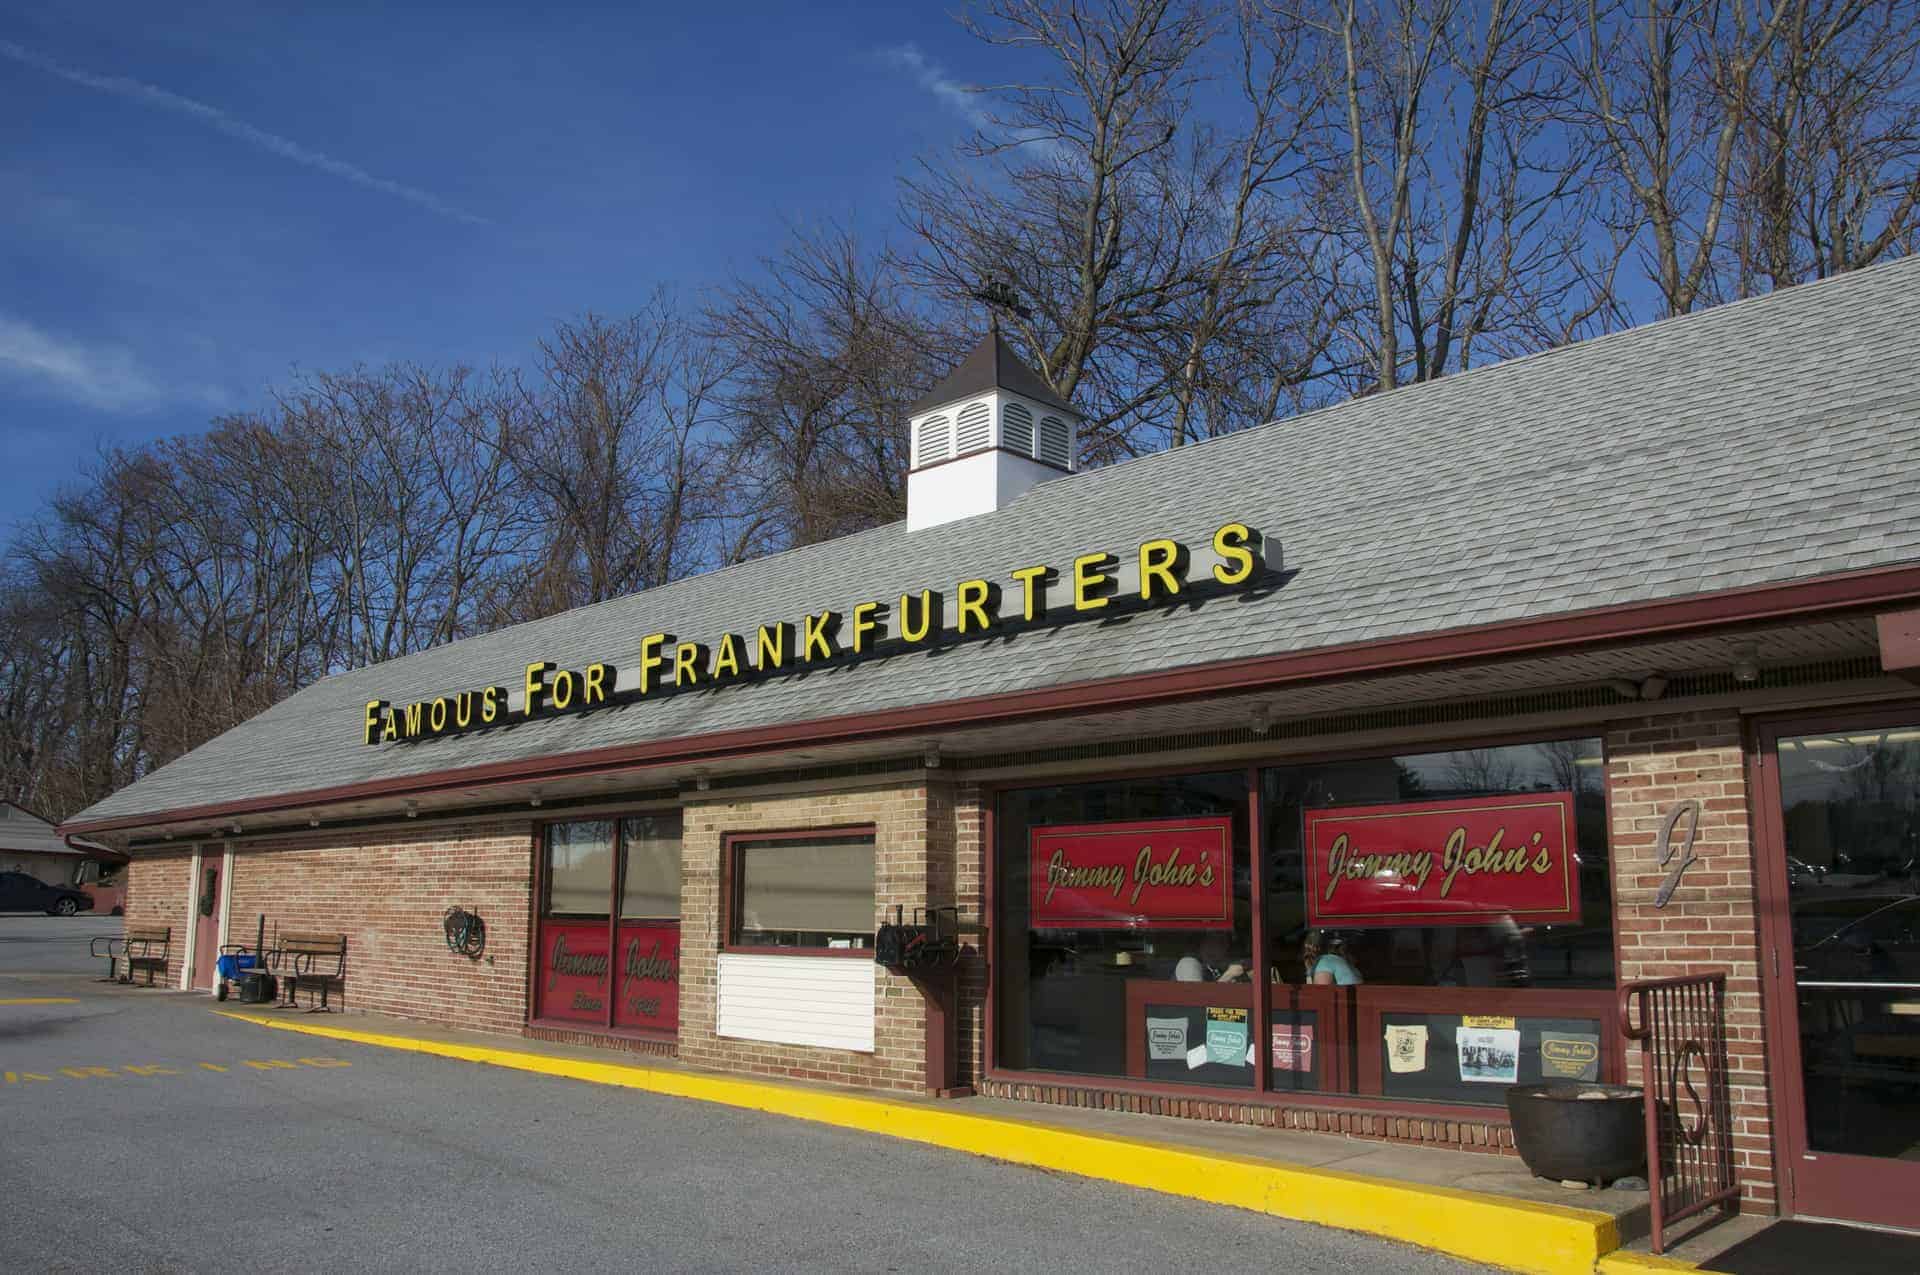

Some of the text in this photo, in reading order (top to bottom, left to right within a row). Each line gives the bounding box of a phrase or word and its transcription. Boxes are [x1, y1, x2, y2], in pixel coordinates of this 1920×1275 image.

[364, 521, 1256, 745] FAMOUS FOR FRANKFURTERS
[1044, 845, 1216, 905] Jimmy John's
[1324, 825, 1553, 901] Jimmy John's
[549, 934, 608, 992] Jimmy
